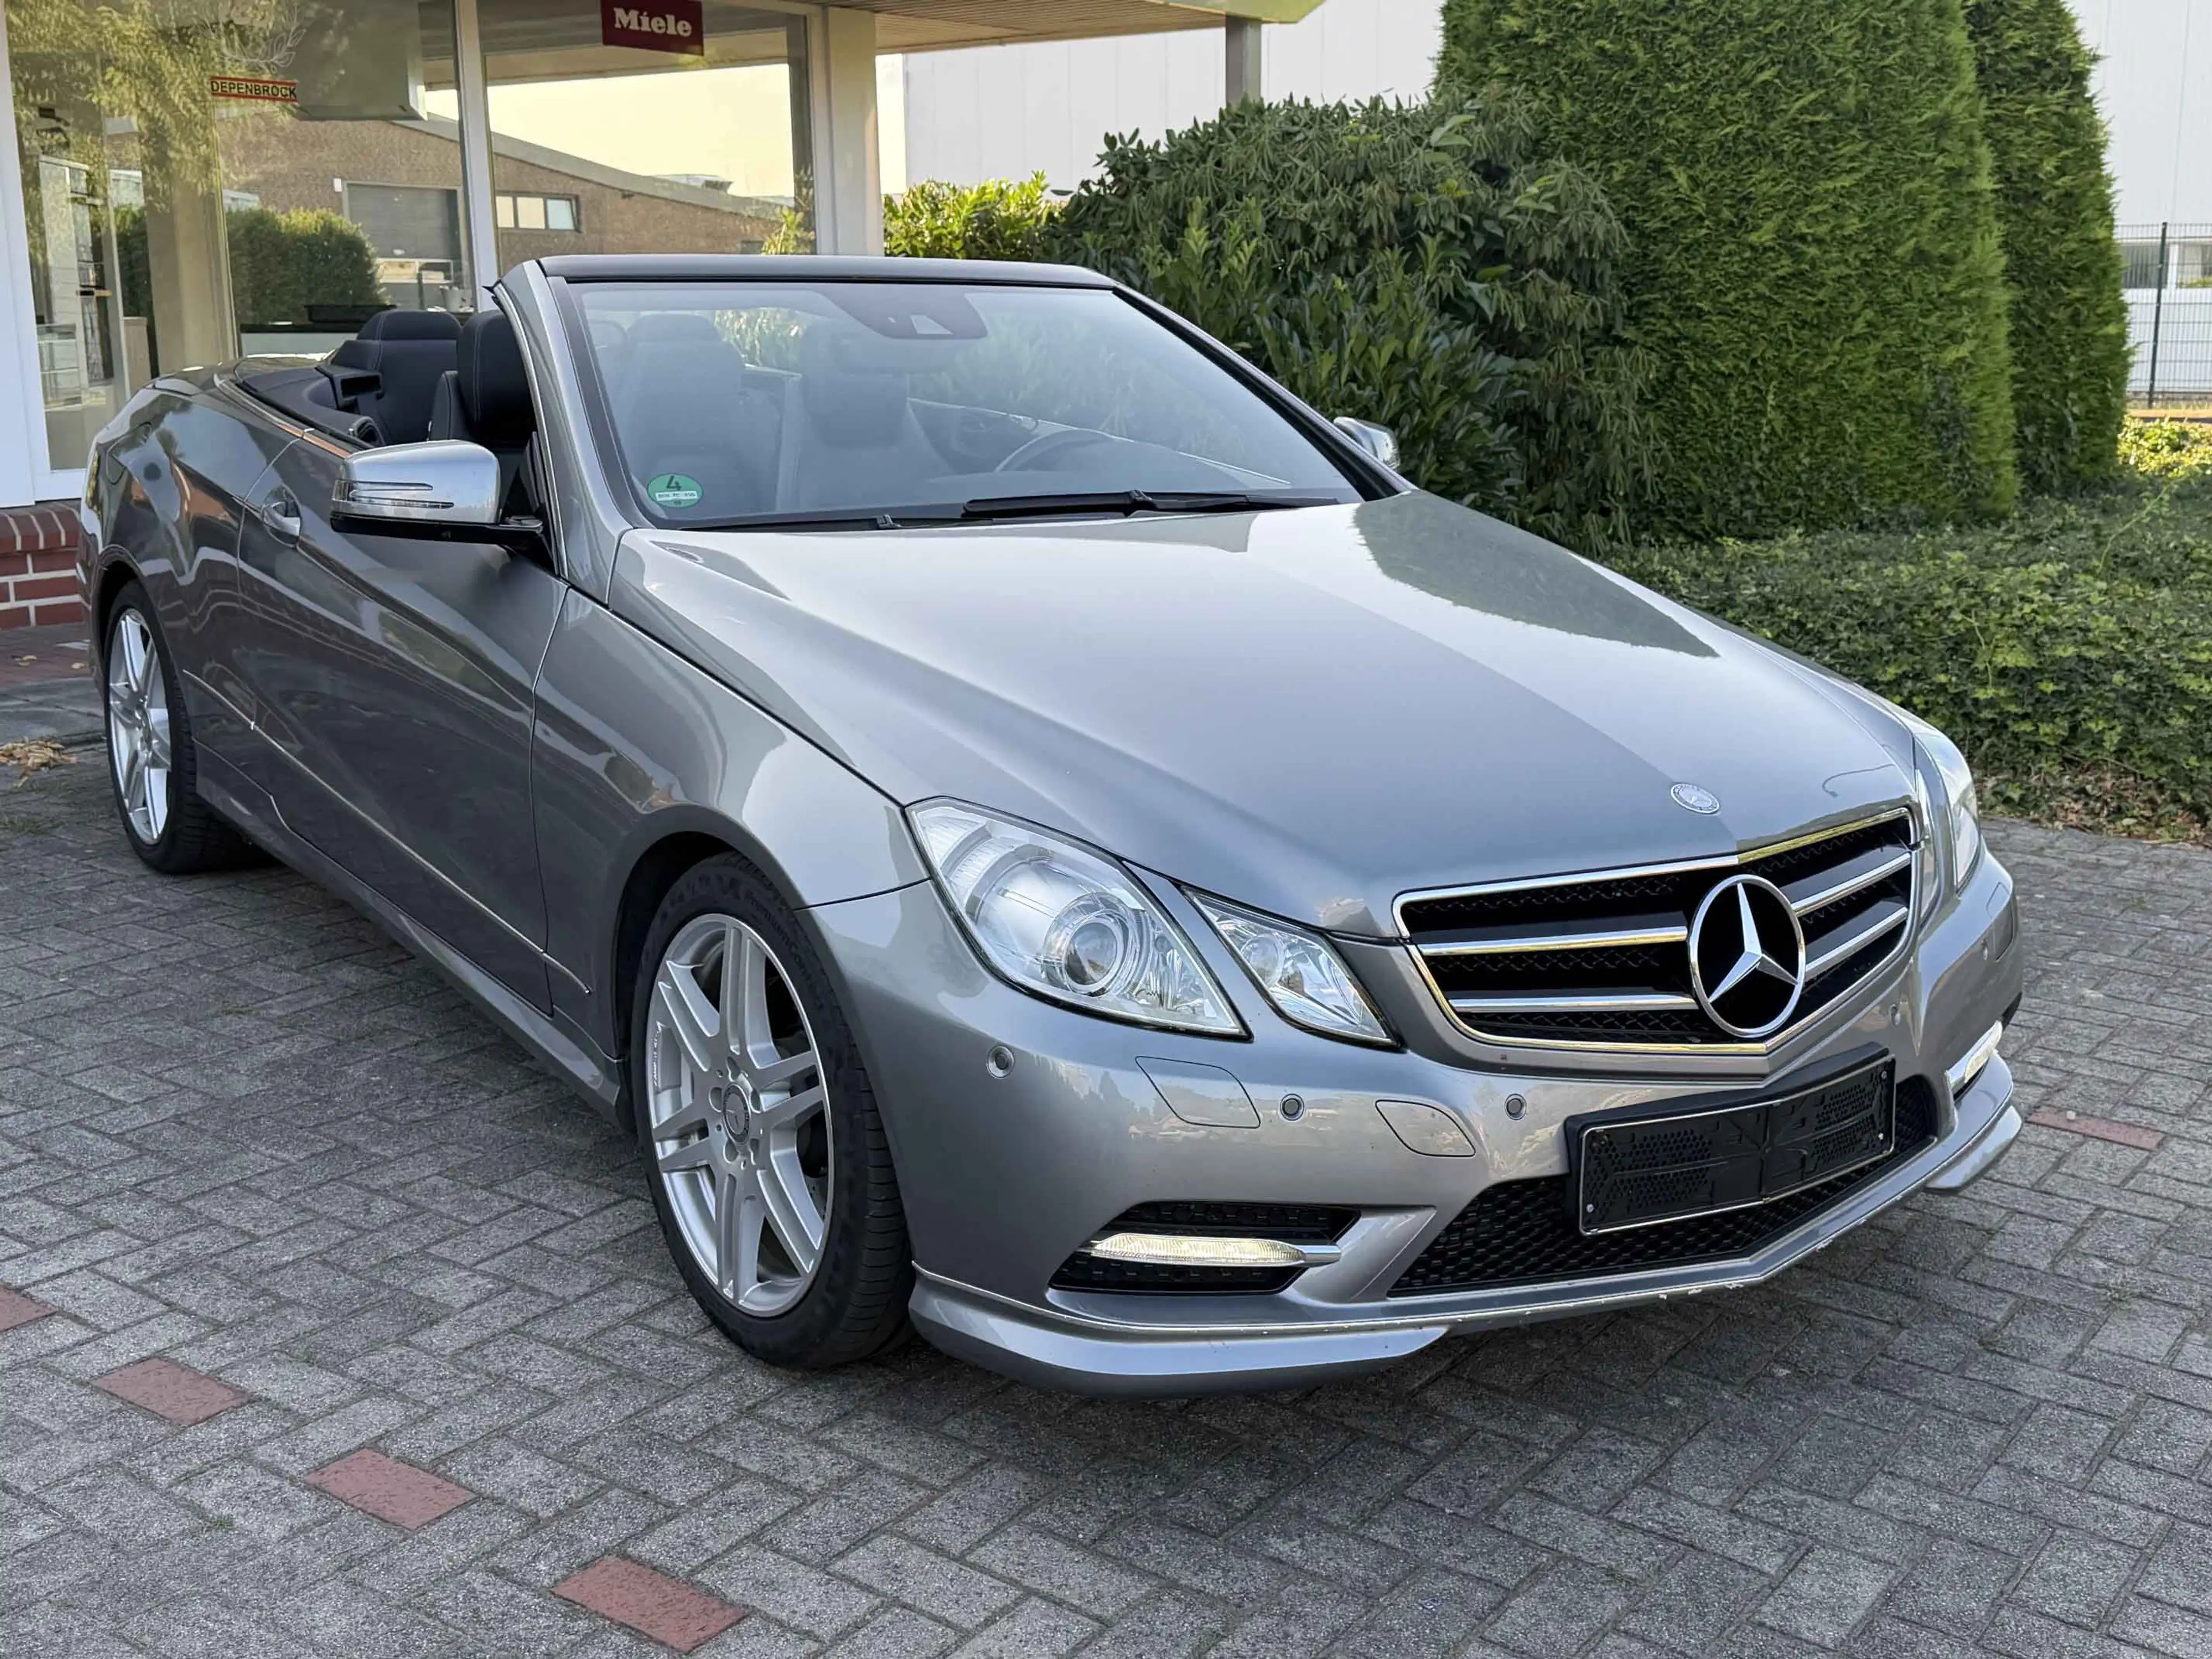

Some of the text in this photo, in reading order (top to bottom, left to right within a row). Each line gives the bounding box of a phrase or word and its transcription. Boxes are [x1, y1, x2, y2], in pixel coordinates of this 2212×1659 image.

[613, 7, 692, 37] Miele
[211, 81, 297, 99] DEPENBROCK
[666, 475, 682, 490] 4
